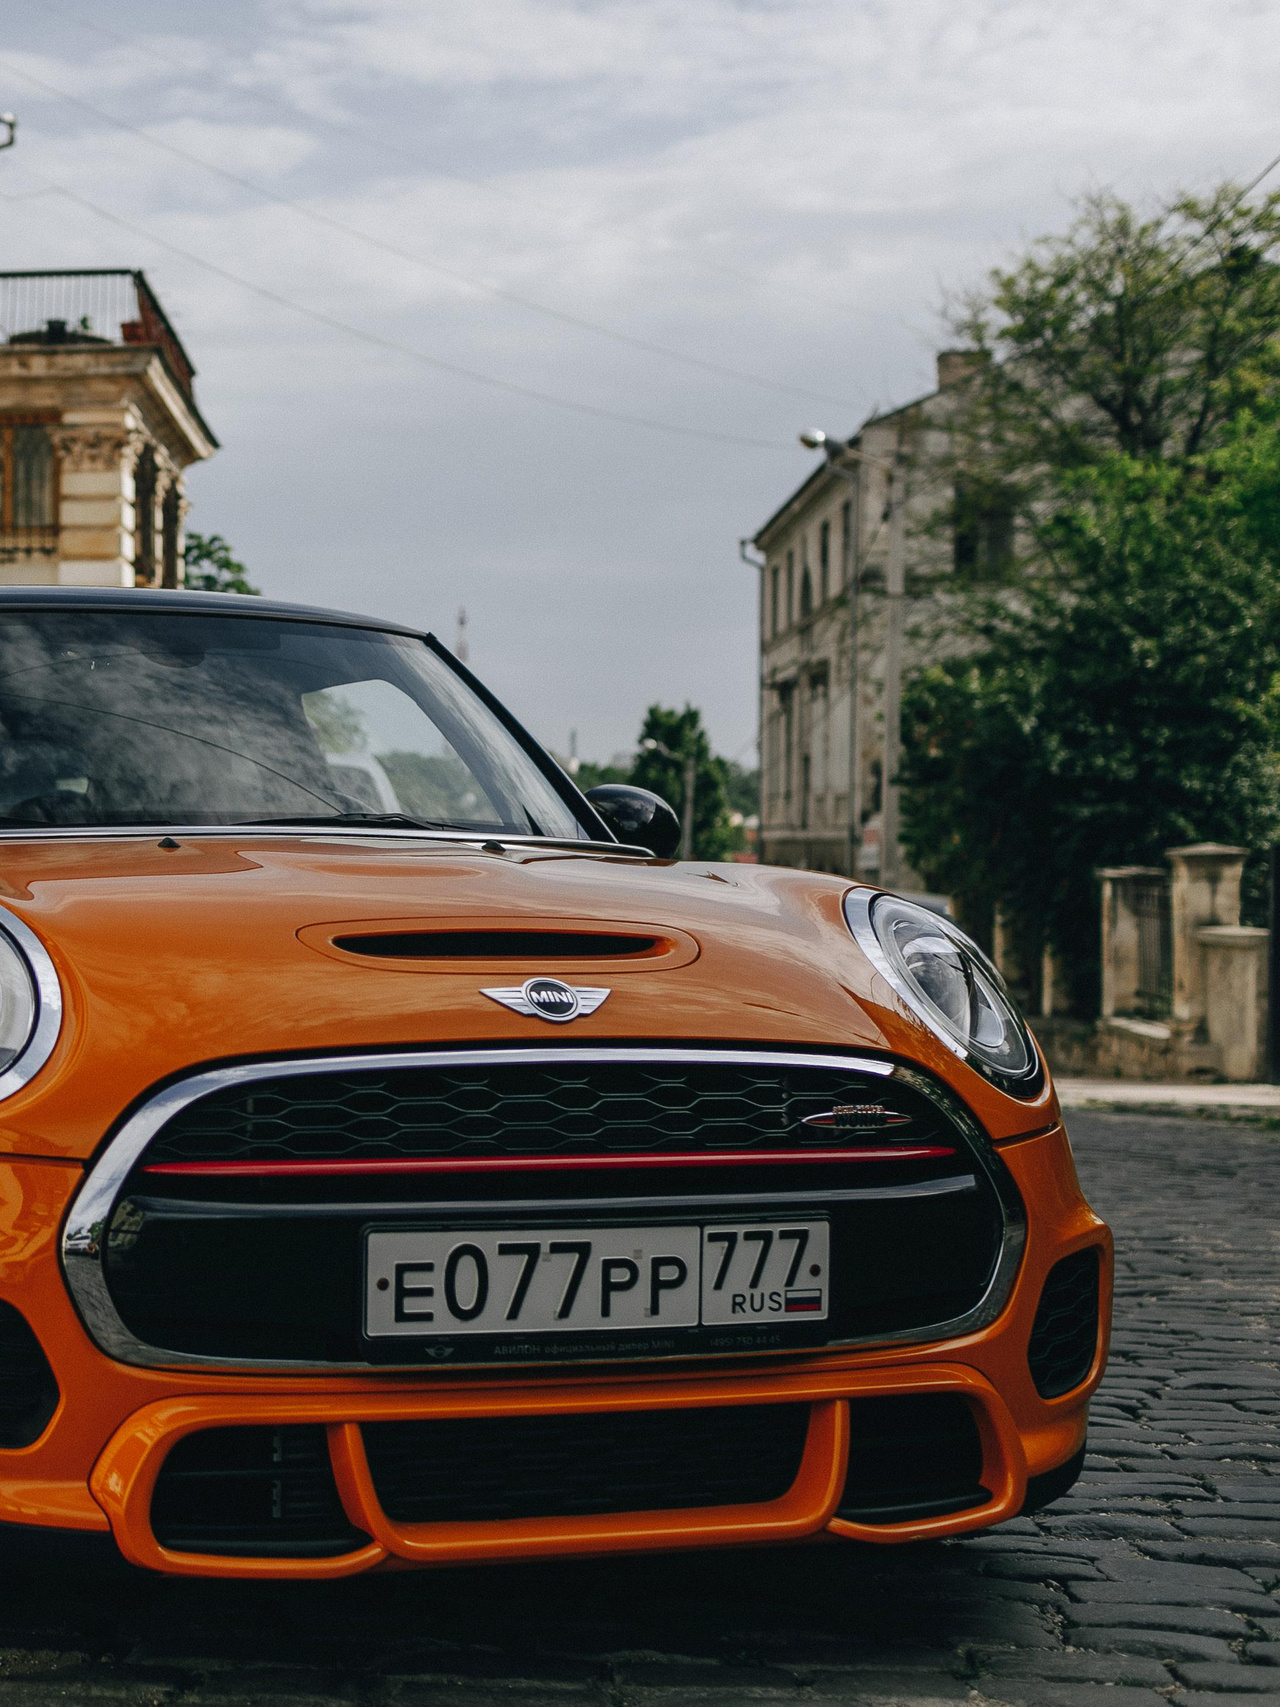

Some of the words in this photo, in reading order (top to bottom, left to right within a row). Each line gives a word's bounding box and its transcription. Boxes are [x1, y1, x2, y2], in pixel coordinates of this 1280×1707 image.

[530, 990, 573, 1003] MINI
[393, 1241, 688, 1323] E077PP
[707, 1228, 810, 1291] 777
[732, 1291, 783, 1314] RUS
[493, 1344, 540, 1355] АВИЛОН
